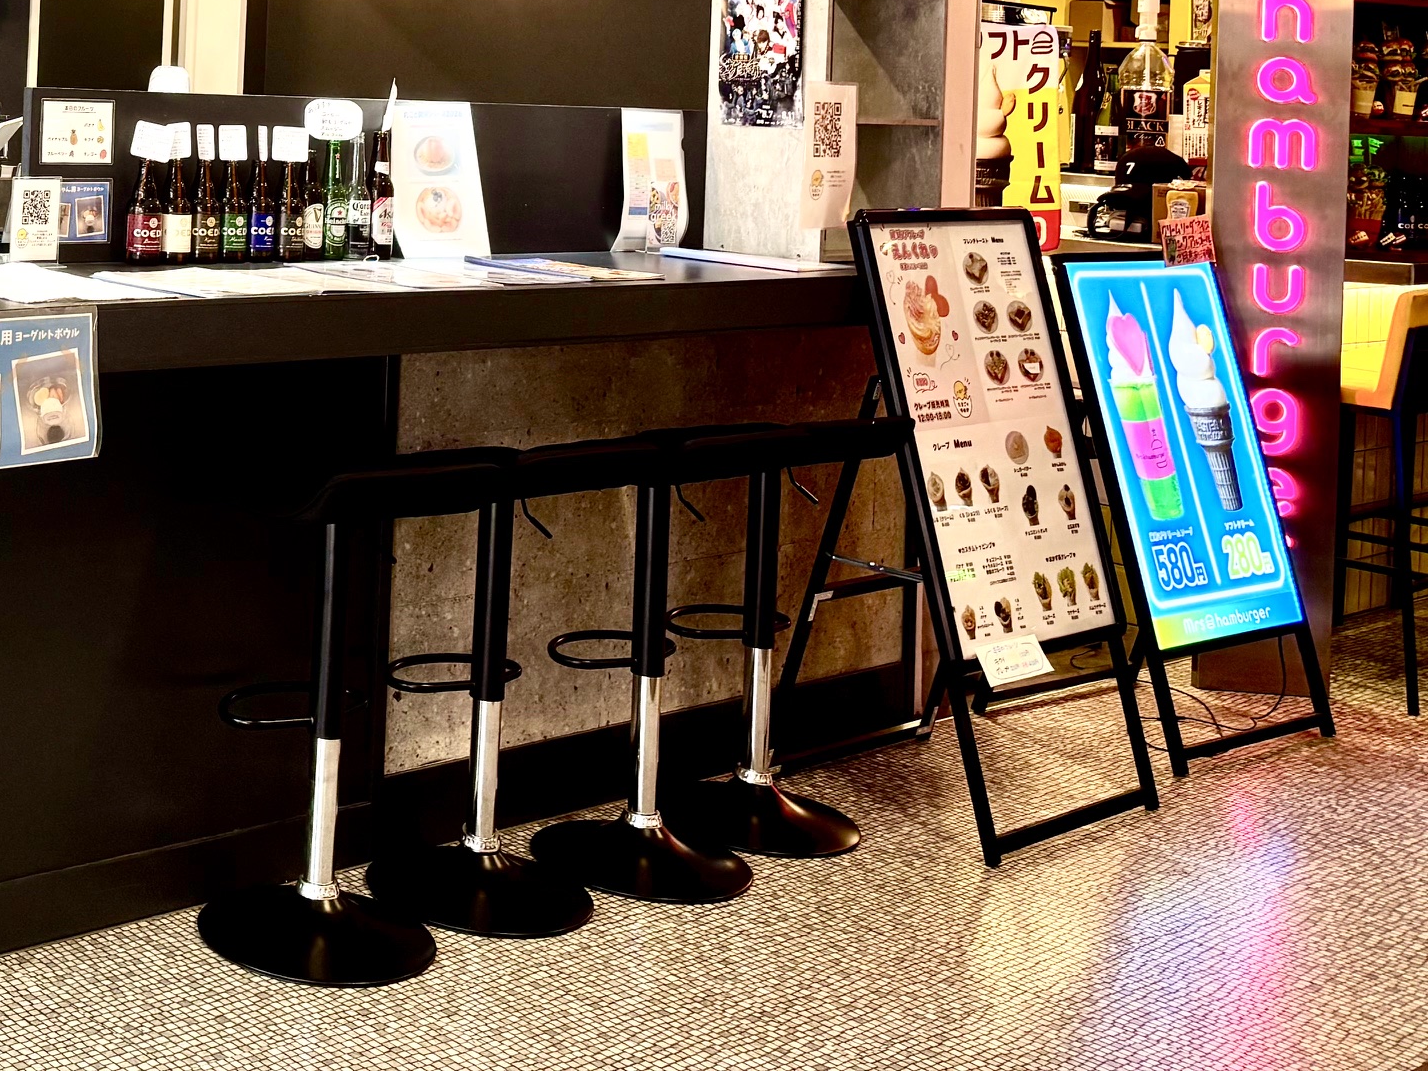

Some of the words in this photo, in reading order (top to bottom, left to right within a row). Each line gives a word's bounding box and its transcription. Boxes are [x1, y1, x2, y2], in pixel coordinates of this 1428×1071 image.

[980, 30, 1029, 60] フト
[1027, 63, 1055, 204] クリーム
[1126, 162, 1136, 174] 7
[649, 211, 678, 224] greek
[133, 228, 162, 238] COED
[192, 227, 220, 237] COED
[222, 226, 247, 236] COED
[251, 226, 273, 236] COE
[281, 227, 303, 236] COE
[14, 327, 80, 343] ヨーグルトボウル
[953, 438, 972, 449] Menu
[1215, 607, 1271, 626] hamburger
